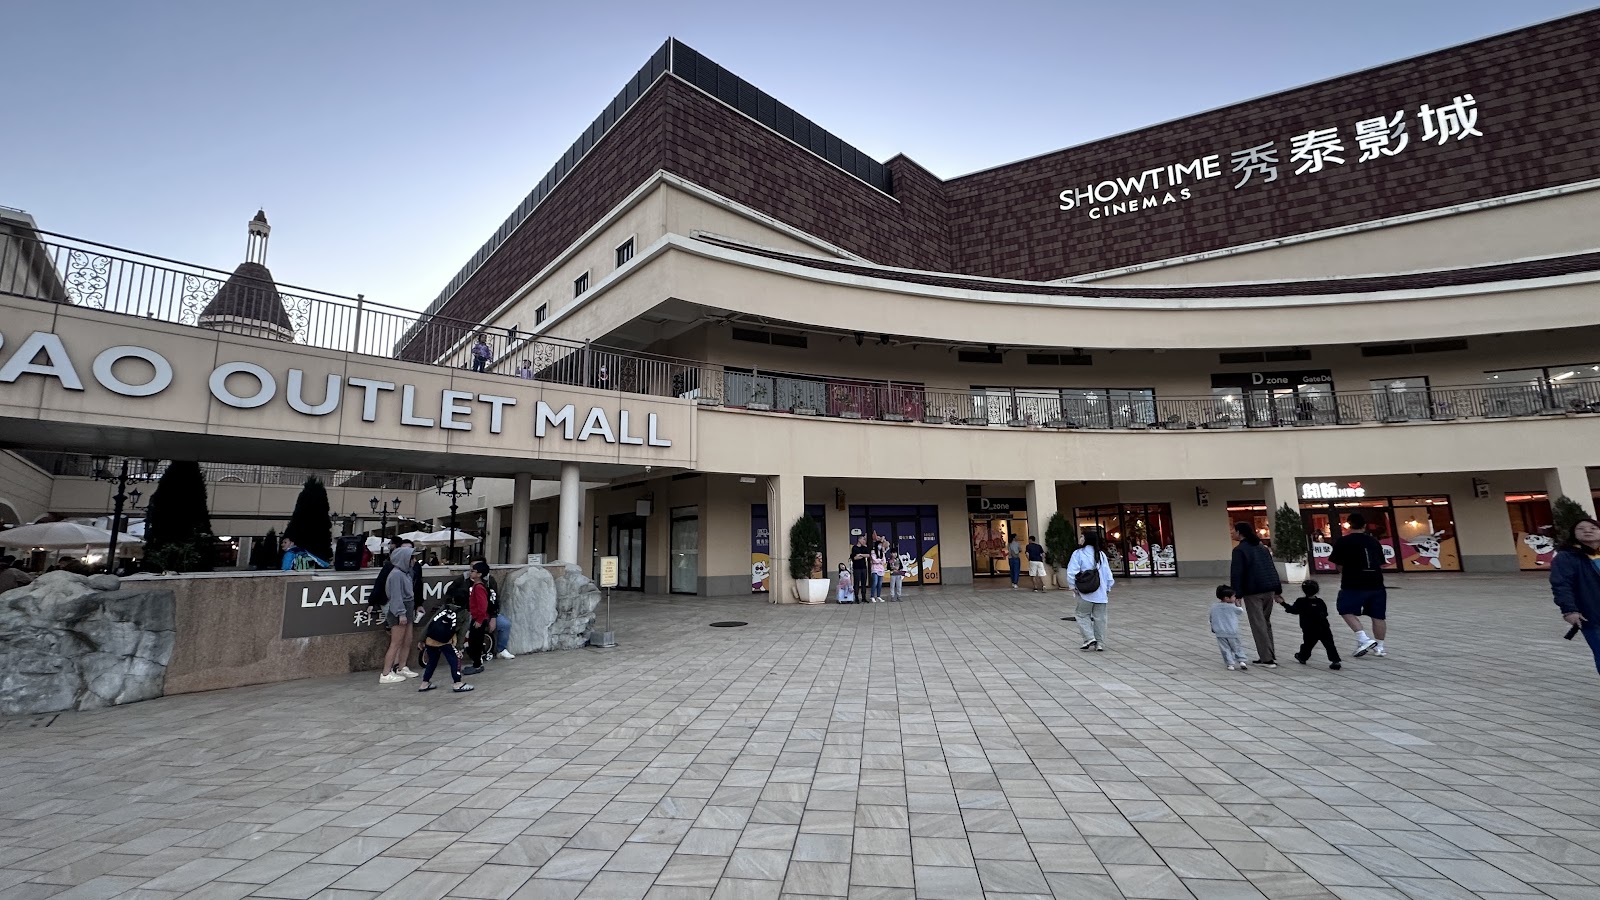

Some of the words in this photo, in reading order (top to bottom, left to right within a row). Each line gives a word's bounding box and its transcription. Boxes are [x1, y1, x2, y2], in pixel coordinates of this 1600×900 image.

[1231, 93, 1483, 190] 秀泰影城
[1059, 154, 1222, 211] SHOWTIME
[1089, 188, 1192, 220] CINEMAS
[0, 330, 174, 397] AO
[208, 360, 518, 435] OUTLET
[534, 400, 672, 447] MALL
[1266, 377, 1289, 385] zone
[1302, 375, 1320, 383] Gate
